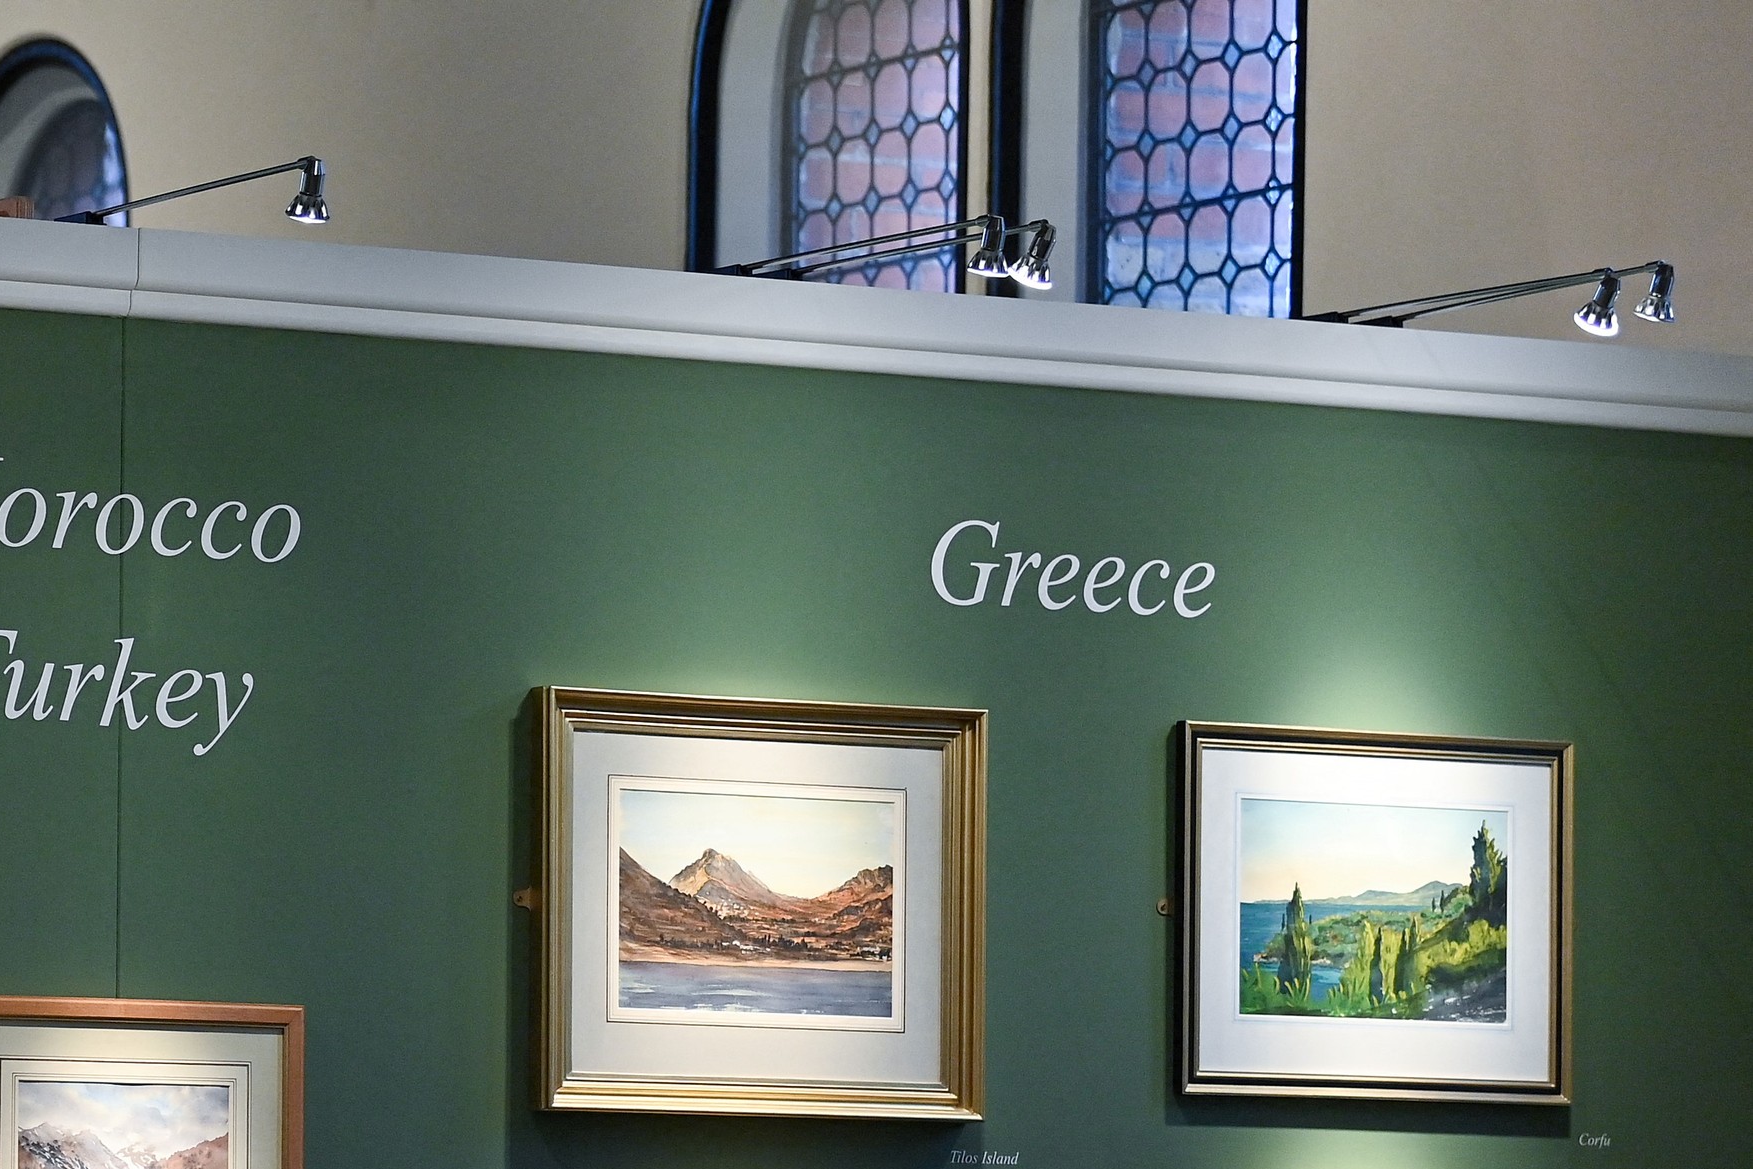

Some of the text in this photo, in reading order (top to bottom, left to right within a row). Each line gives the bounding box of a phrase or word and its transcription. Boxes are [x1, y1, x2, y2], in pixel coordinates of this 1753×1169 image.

[931, 519, 1216, 618] Greece
[1578, 1132, 1611, 1149] Corfu
[950, 1150, 1020, 1165] Tilos Island
